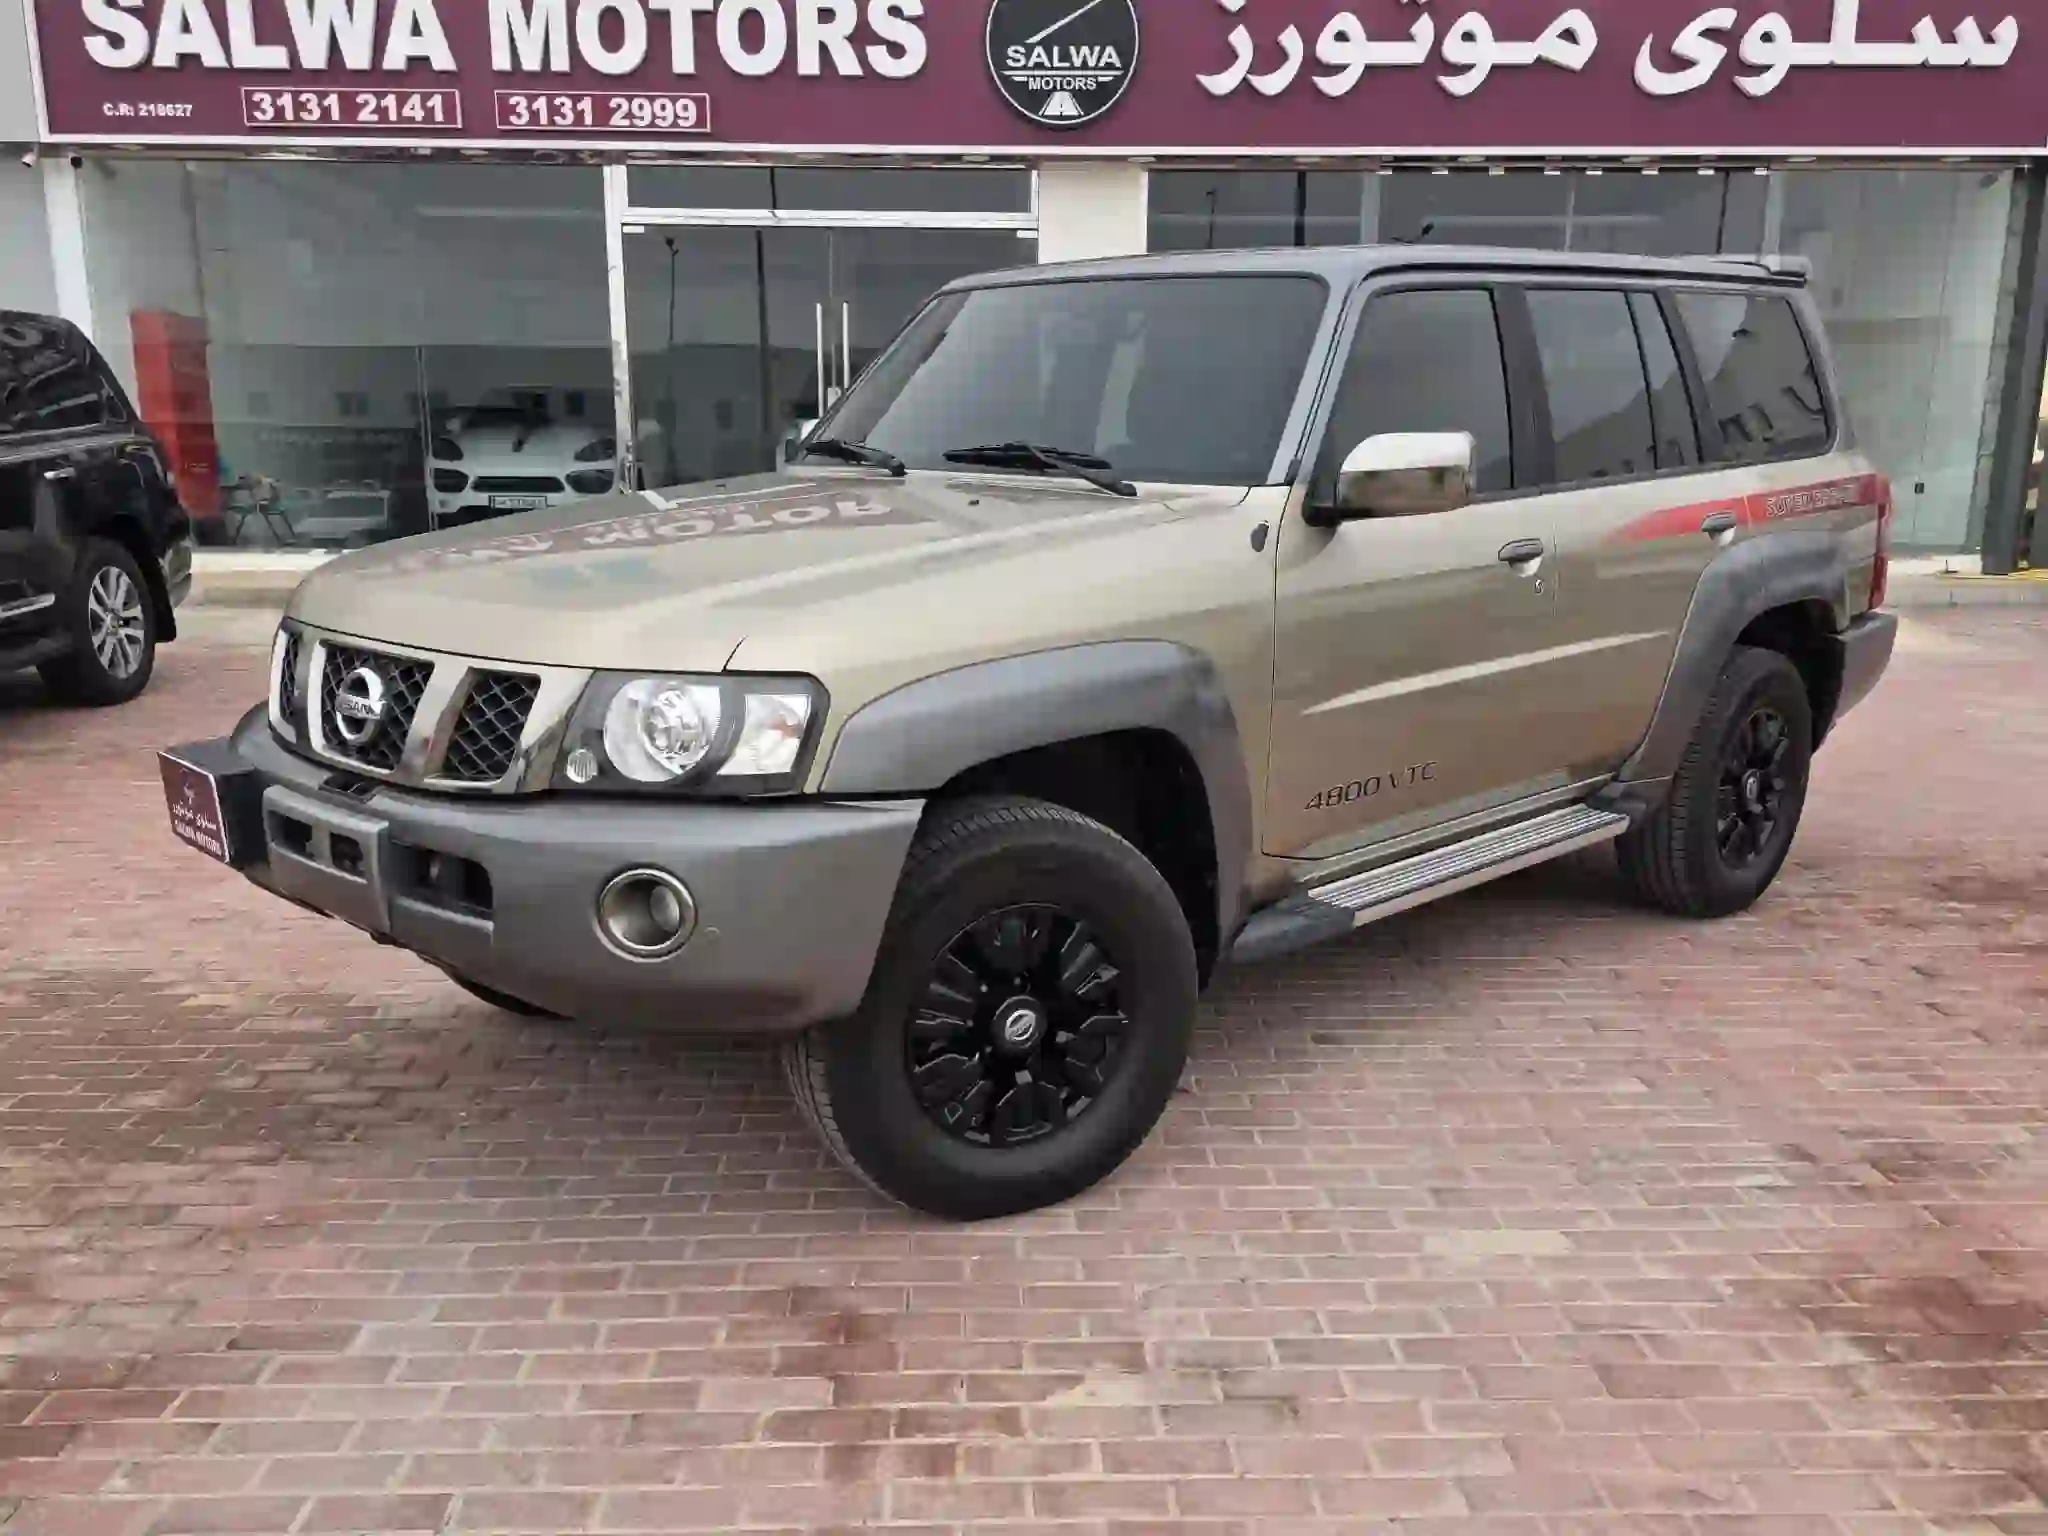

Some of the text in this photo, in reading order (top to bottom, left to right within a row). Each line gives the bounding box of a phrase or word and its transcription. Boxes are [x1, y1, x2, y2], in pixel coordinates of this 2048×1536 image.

[83, 0, 928, 78] SALWA MOTORS
[1633, 0, 2019, 97] سلوى
[1006, 45, 1122, 68] SALWA
[1028, 77, 1097, 91] MOTORS
[252, 92, 445, 123] 3131 2141
[508, 95, 697, 128] 3131 2999
[1303, 776, 1382, 811] 4800
